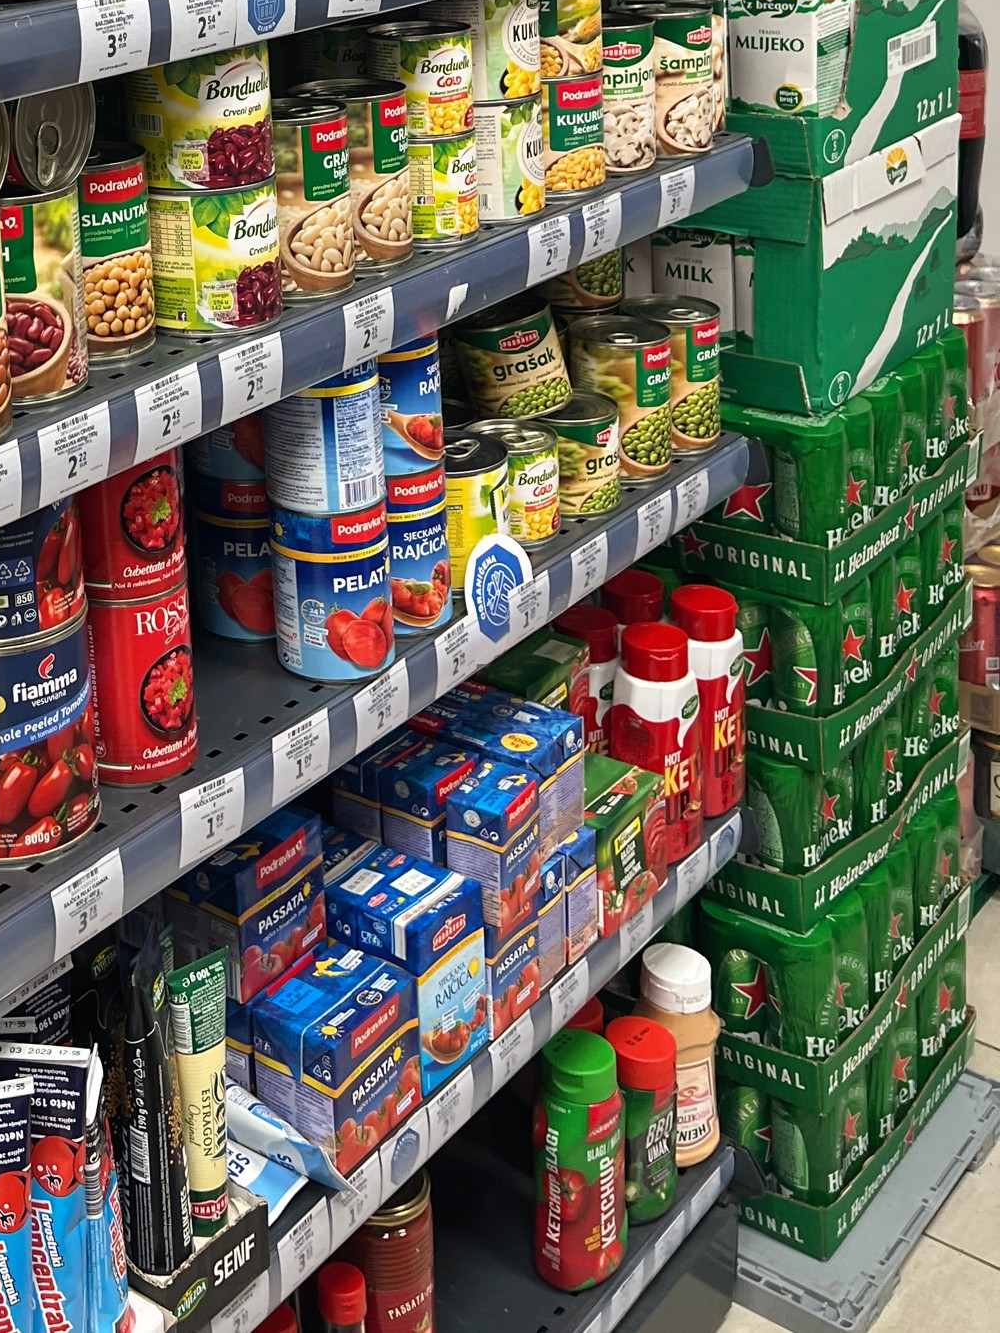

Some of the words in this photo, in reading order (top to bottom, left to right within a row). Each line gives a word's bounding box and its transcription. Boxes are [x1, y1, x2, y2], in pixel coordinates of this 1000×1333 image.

[736, 36, 804, 53] MLIJEKO
[421, 54, 469, 76] Bonduelle
[223, 107, 244, 117] Crveni
[82, 205, 149, 227] SLANUTAK
[665, 262, 712, 283] MILK
[493, 348, 555, 381] grašak
[403, 526, 442, 542] SJECKANA
[848, 524, 900, 578] Heineken
[919, 465, 966, 518] ORIGINAL
[393, 535, 446, 560] RAJČICA
[715, 544, 812, 582] ORIGINAL
[15, 591, 34, 606] 850
[13, 667, 78, 704] fiamma
[31, 688, 67, 708] vesuviana
[23, 712, 59, 737] Peeled
[714, 709, 730, 723] HOT
[24, 828, 51, 846] 800g
[257, 893, 305, 935] PASSATA
[351, 1059, 396, 1106] PASSATA
[187, 1104, 199, 1146] Original
[201, 1089, 212, 1157] ESTRAGON
[645, 1116, 673, 1150] BBQ
[548, 1127, 559, 1170] BLAGI
[648, 1139, 669, 1160] UMAK
[547, 1174, 559, 1242] KETCHUP
[601, 1157, 615, 1248] KETCHUP
[213, 1233, 255, 1286] SENF
[176, 1280, 207, 1316] ZVIJEZDA
